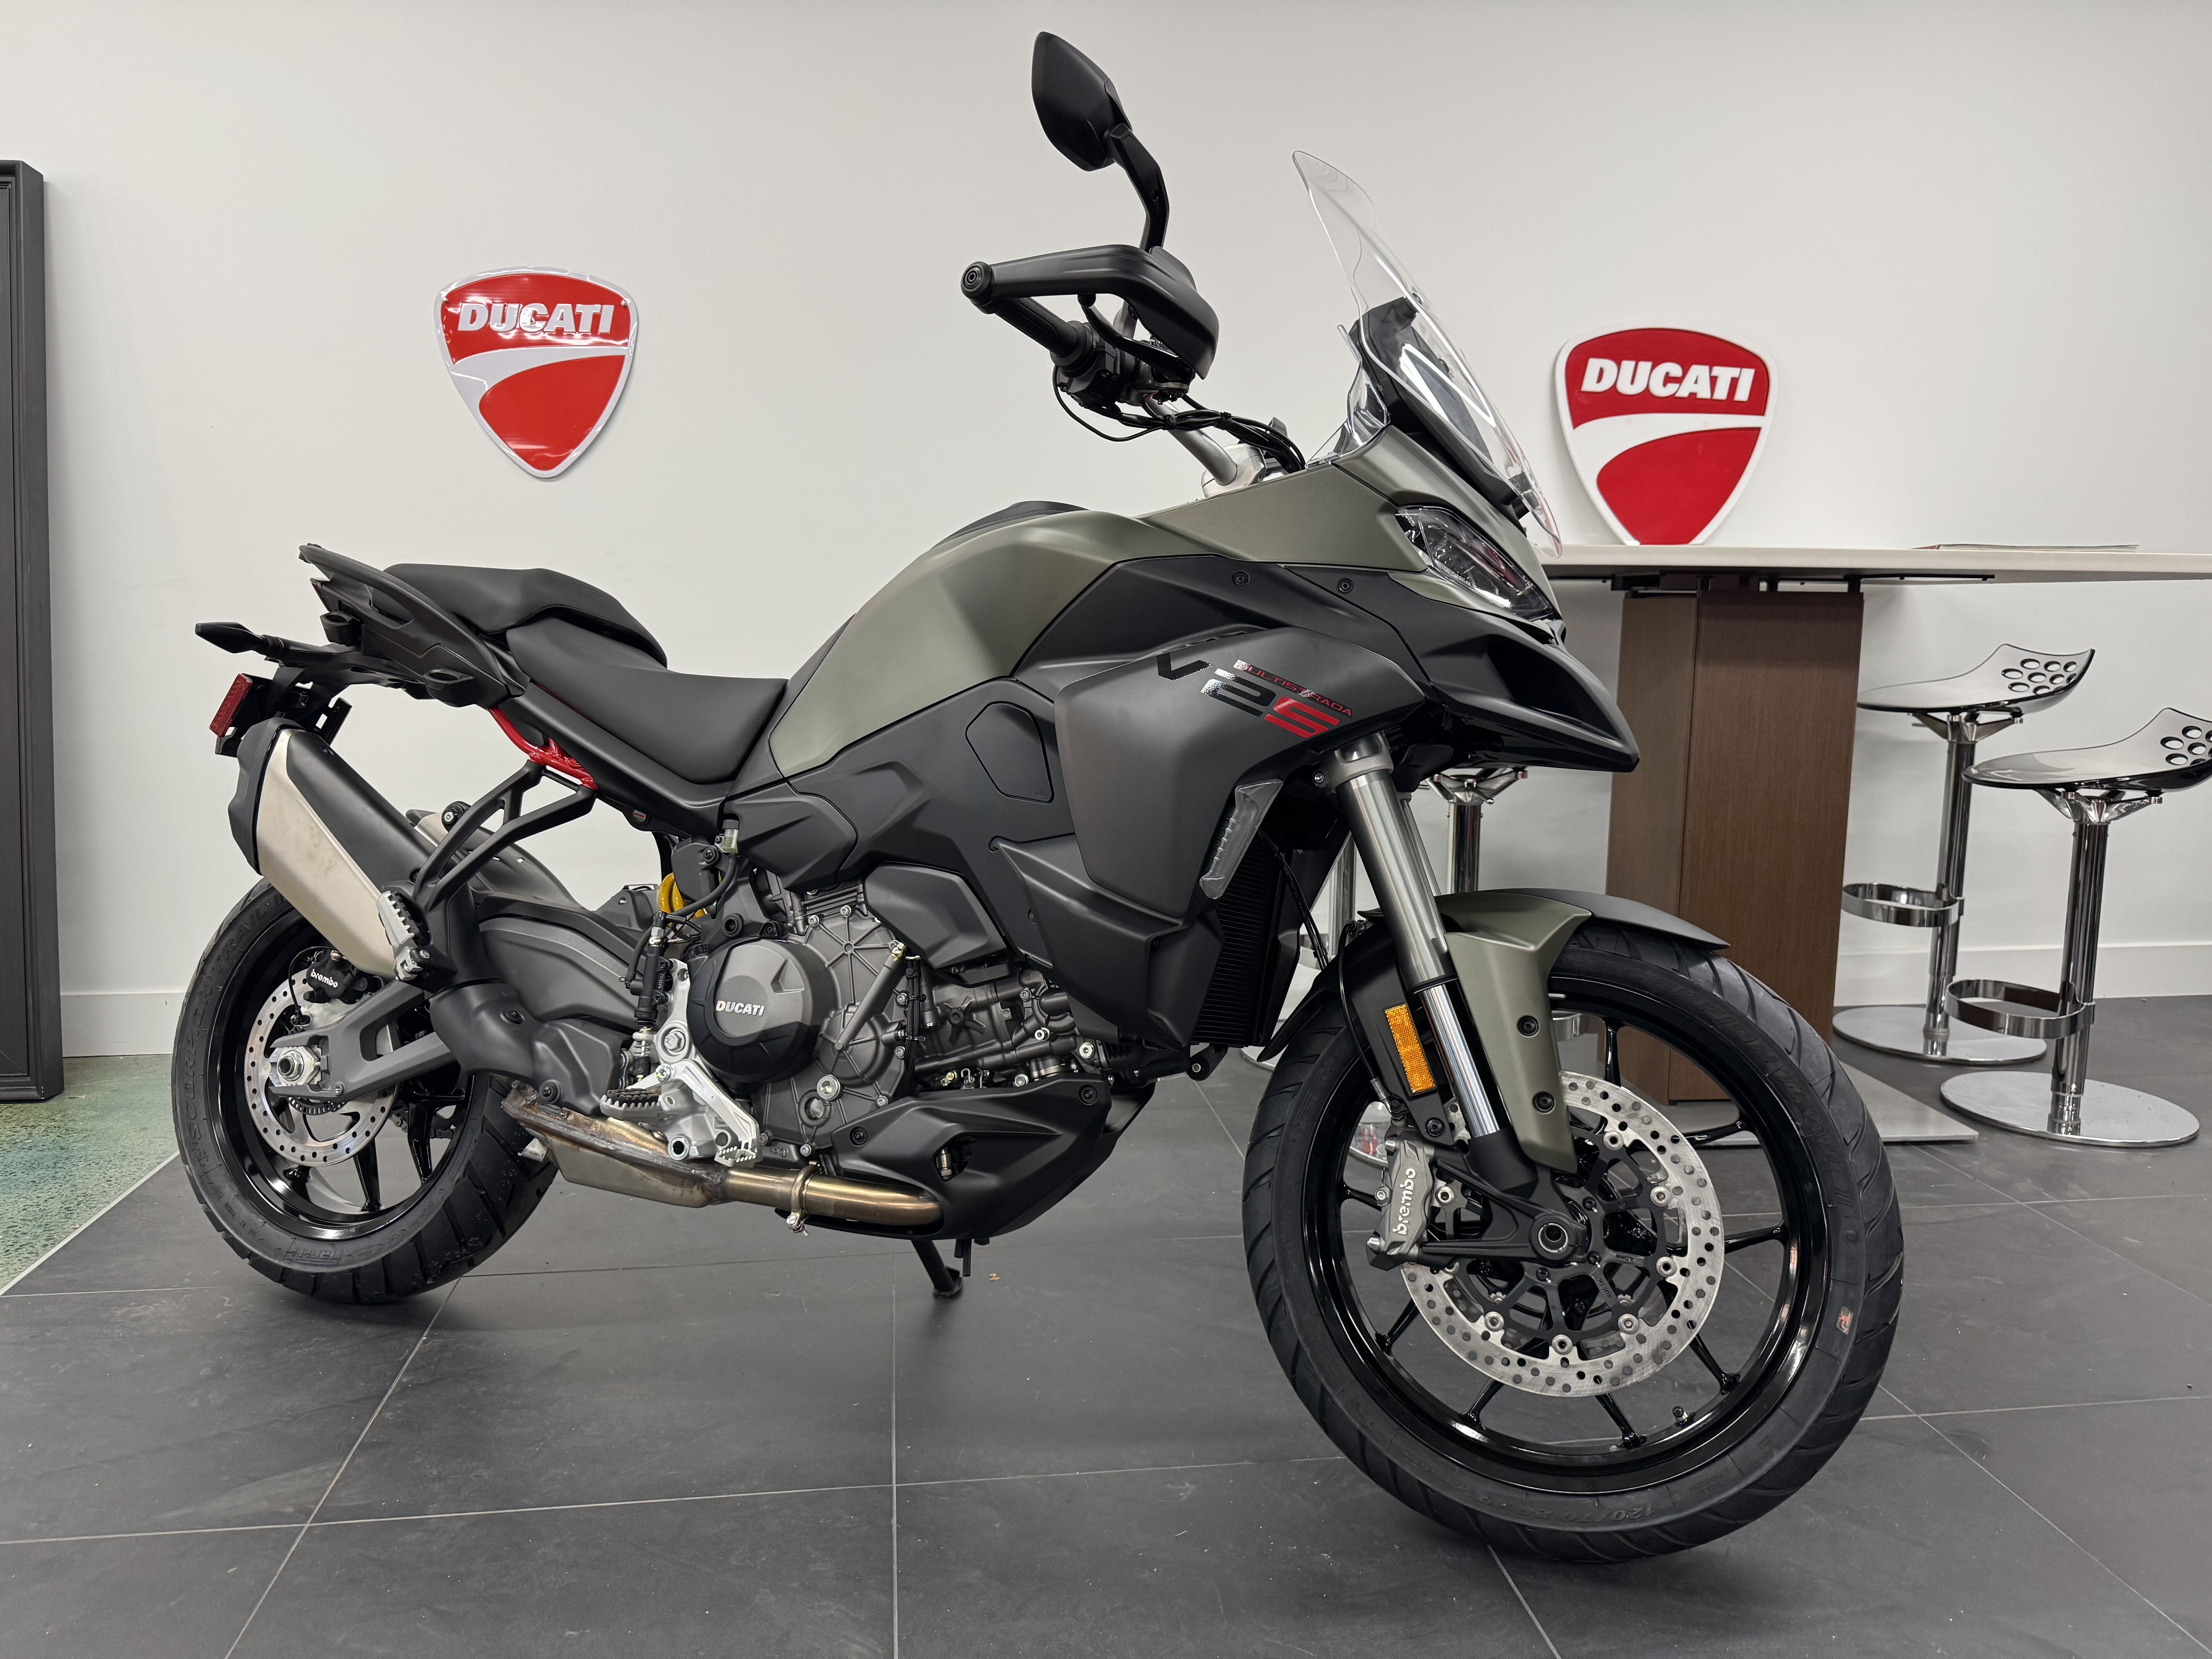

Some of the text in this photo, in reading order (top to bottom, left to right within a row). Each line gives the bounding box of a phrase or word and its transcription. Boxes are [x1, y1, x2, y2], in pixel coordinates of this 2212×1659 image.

[457, 302, 615, 334] DUCATI
[1580, 357, 1755, 402] DUCATI
[311, 969, 338, 988] brembo
[716, 1000, 765, 1016] DUCATI
[1392, 1168, 1416, 1235] brembo
